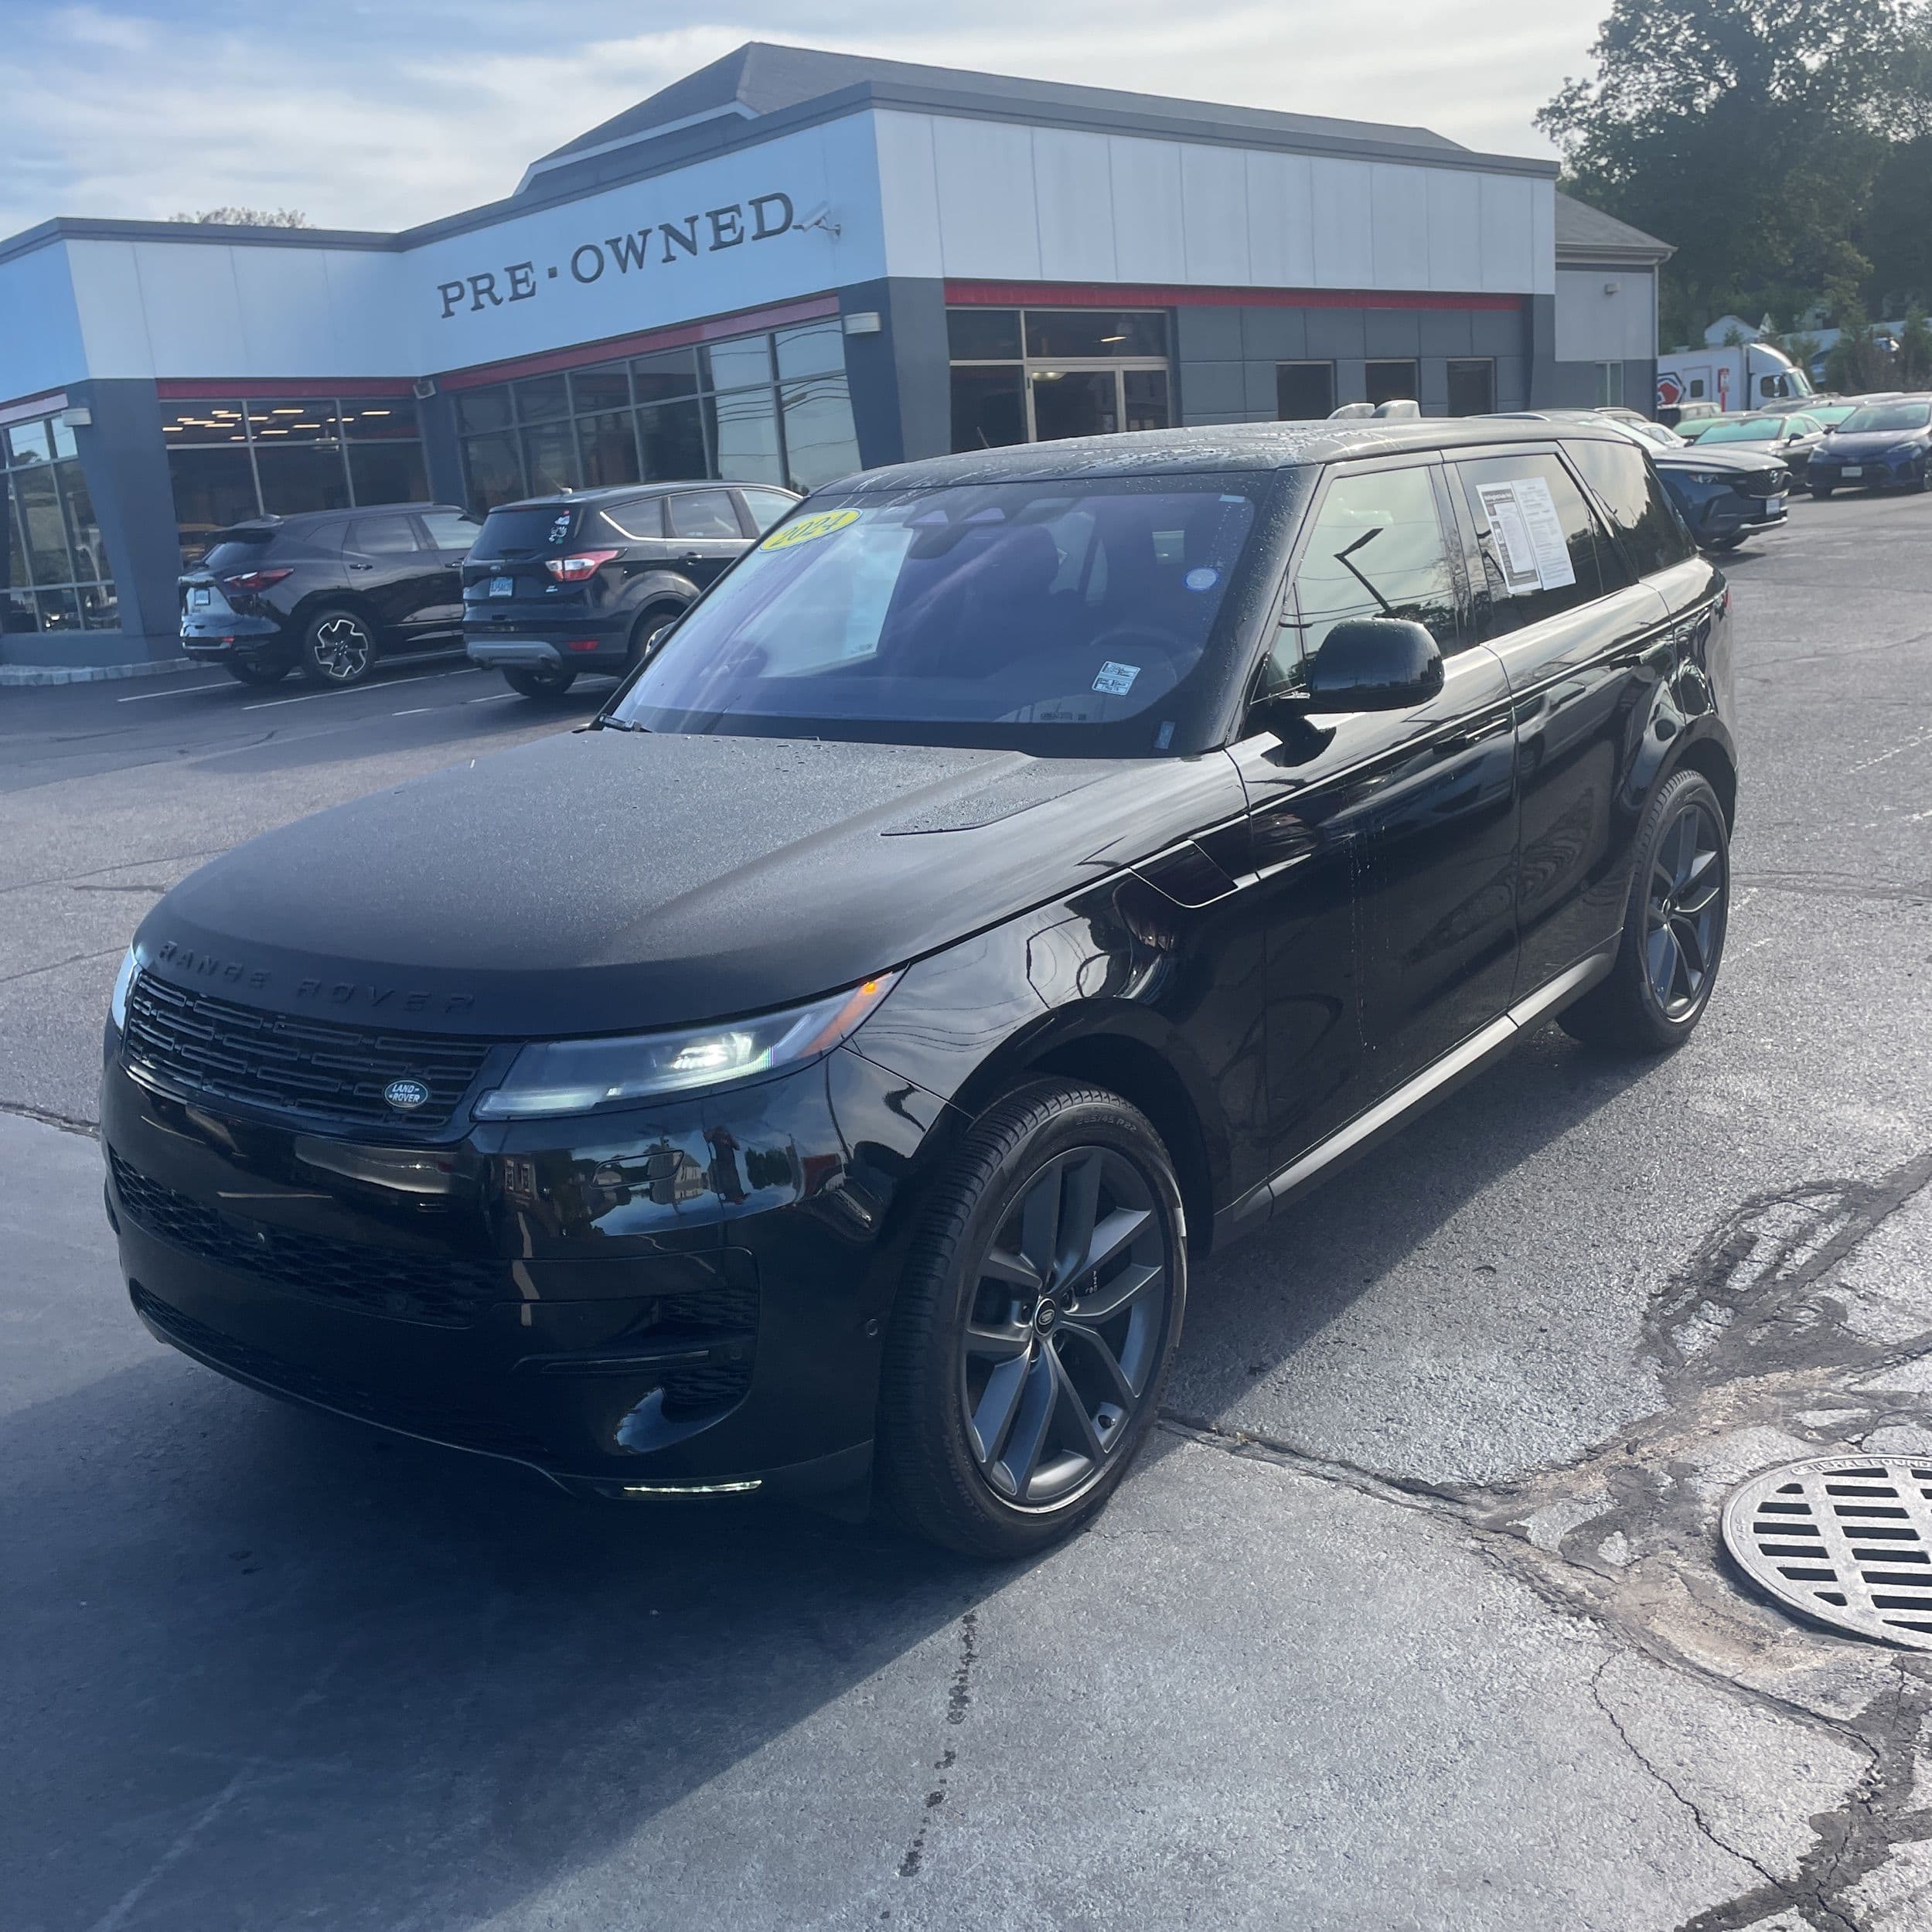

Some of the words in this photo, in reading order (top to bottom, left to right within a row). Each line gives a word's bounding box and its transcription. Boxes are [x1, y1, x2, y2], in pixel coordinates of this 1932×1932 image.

[158, 940, 271, 990] RANGE
[295, 978, 476, 1015] ROVER
[1791, 1459, 1869, 1476] GENERAL
